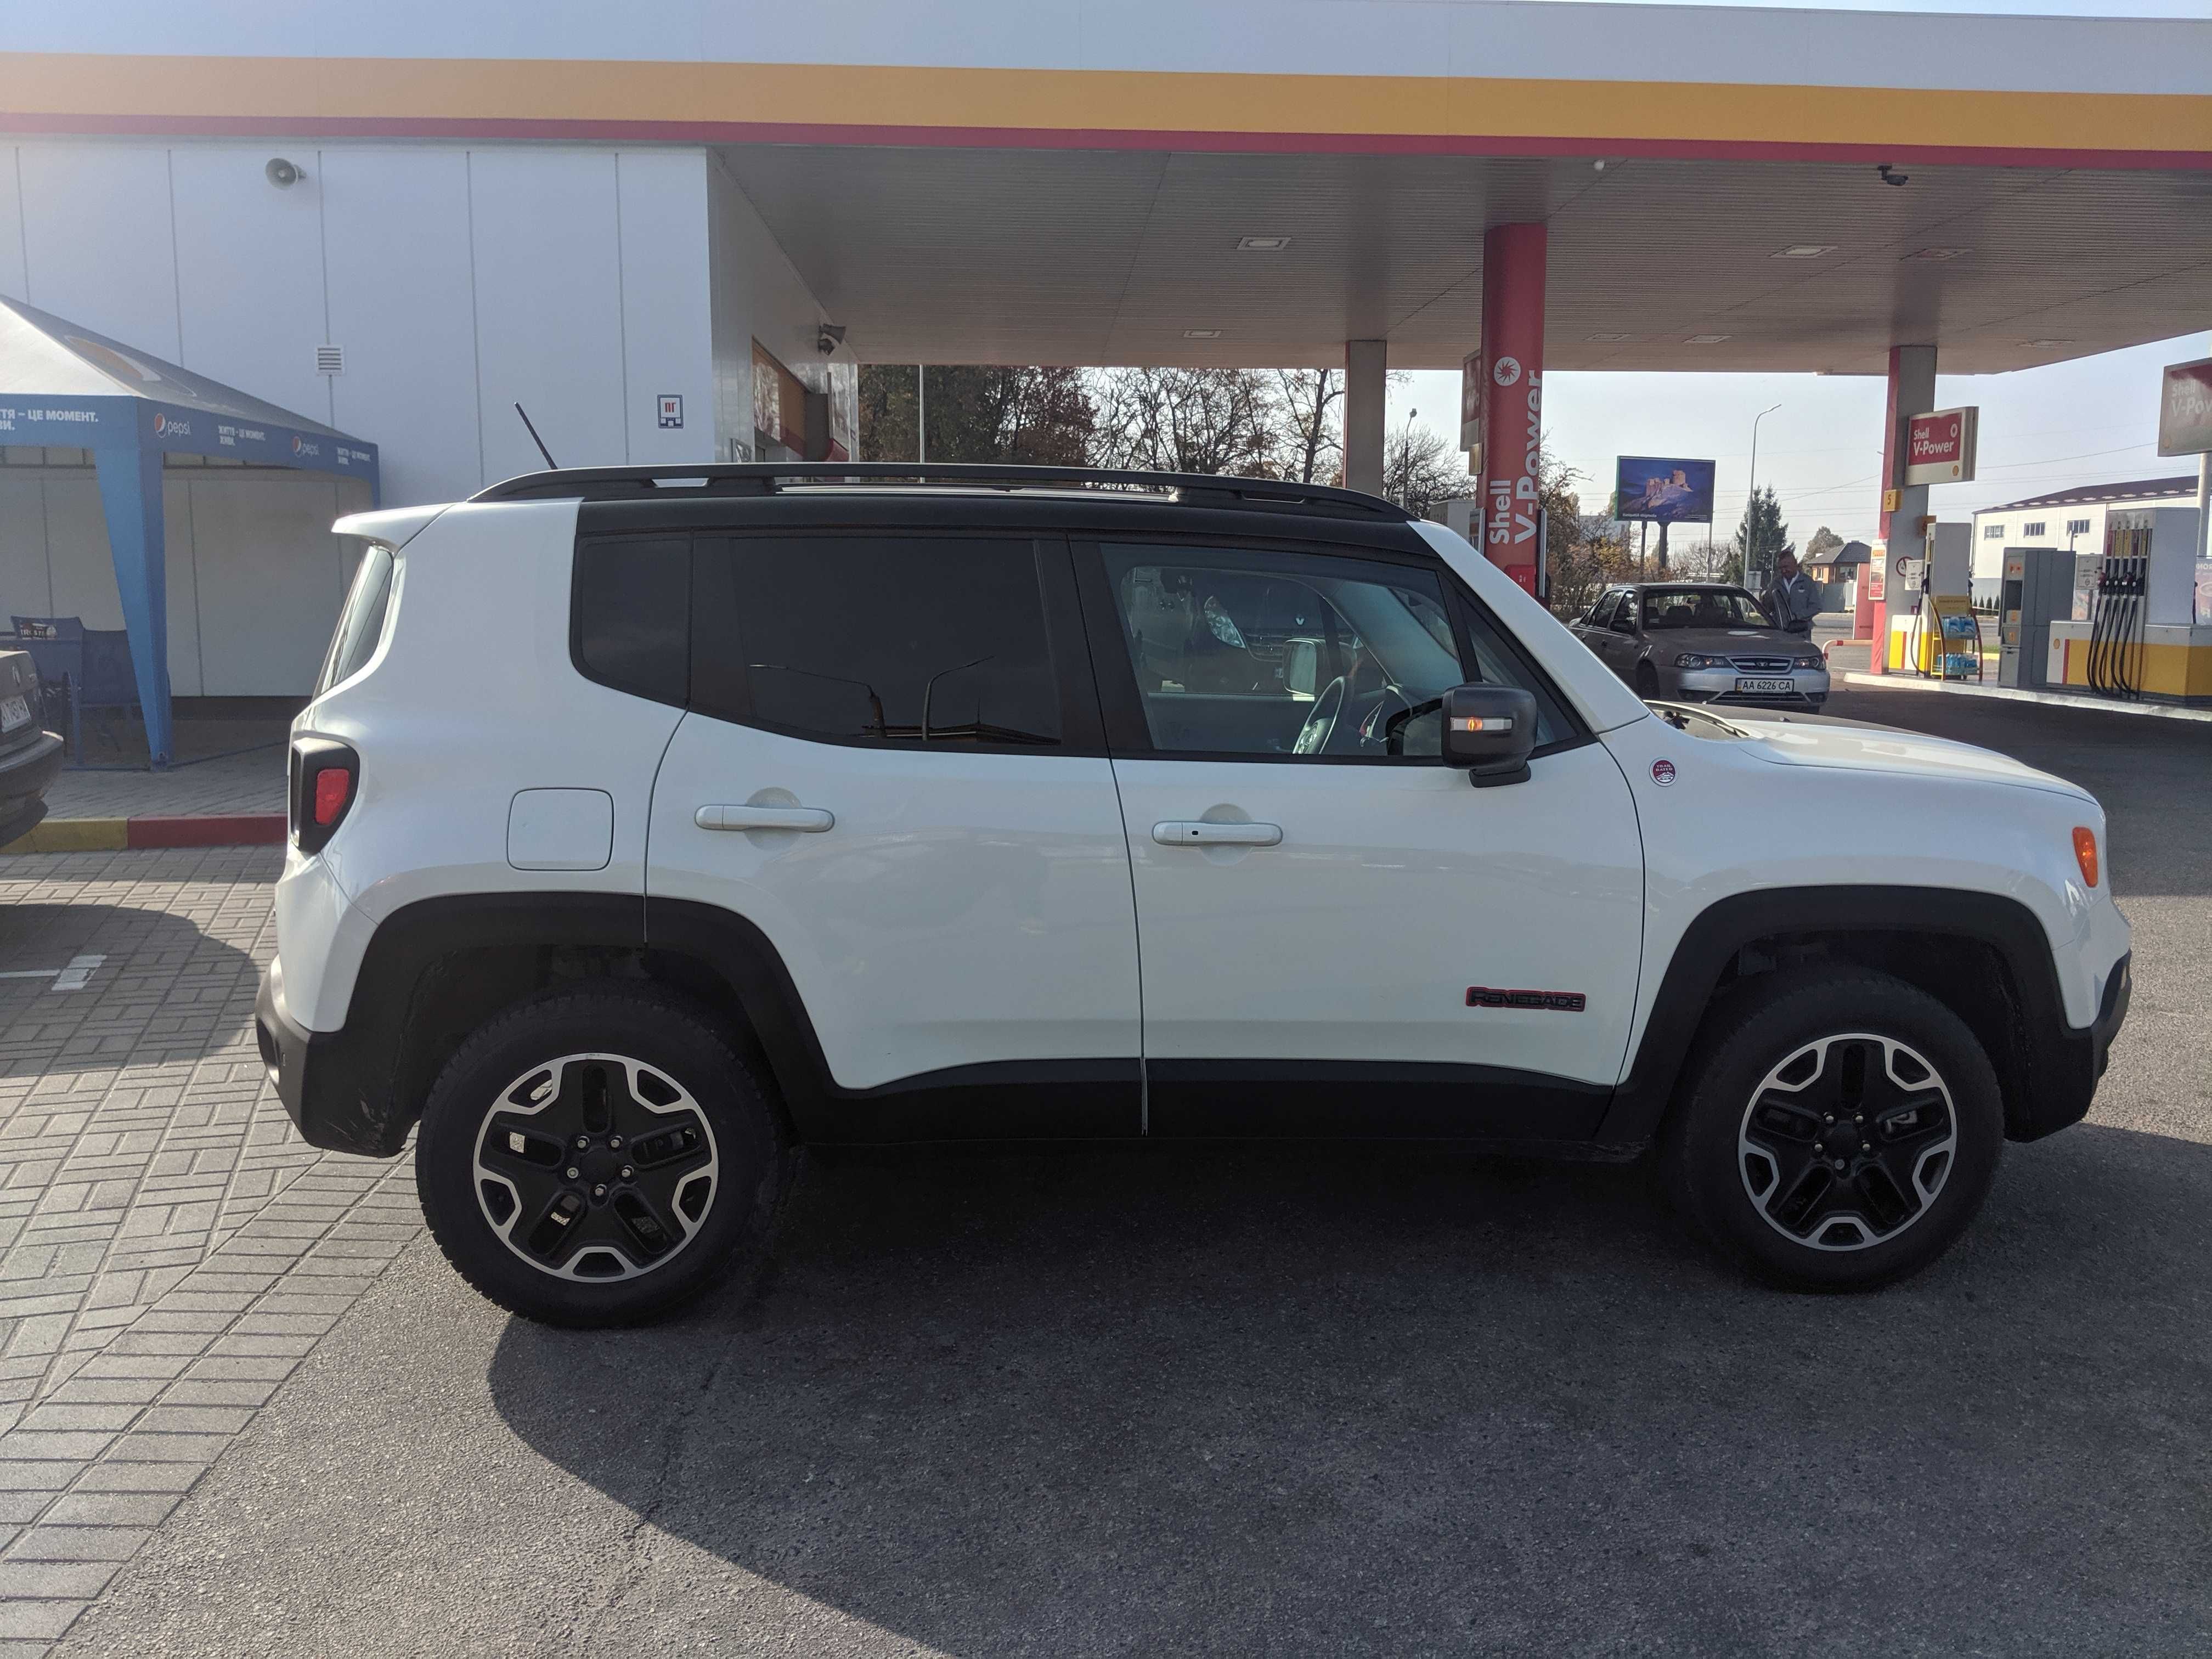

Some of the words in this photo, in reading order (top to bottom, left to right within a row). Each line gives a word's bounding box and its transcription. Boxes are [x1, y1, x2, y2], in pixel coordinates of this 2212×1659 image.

[2172, 380, 2195, 397] Shell
[28, 409, 43, 421] ЦЕ
[46, 410, 99, 422] МОМЕНТ.
[167, 421, 191, 436] pepsi
[1913, 427, 1930, 441] Shell
[1913, 441, 1954, 456] V-Power
[1514, 369, 1542, 545] V-Power
[1887, 494, 1892, 505] 5
[1488, 480, 1511, 545] Shell
[1742, 681, 1754, 690] AA
[1757, 681, 1776, 690] 6226
[1779, 681, 1791, 690] CA
[1469, 989, 1584, 1009] RENEGADE
